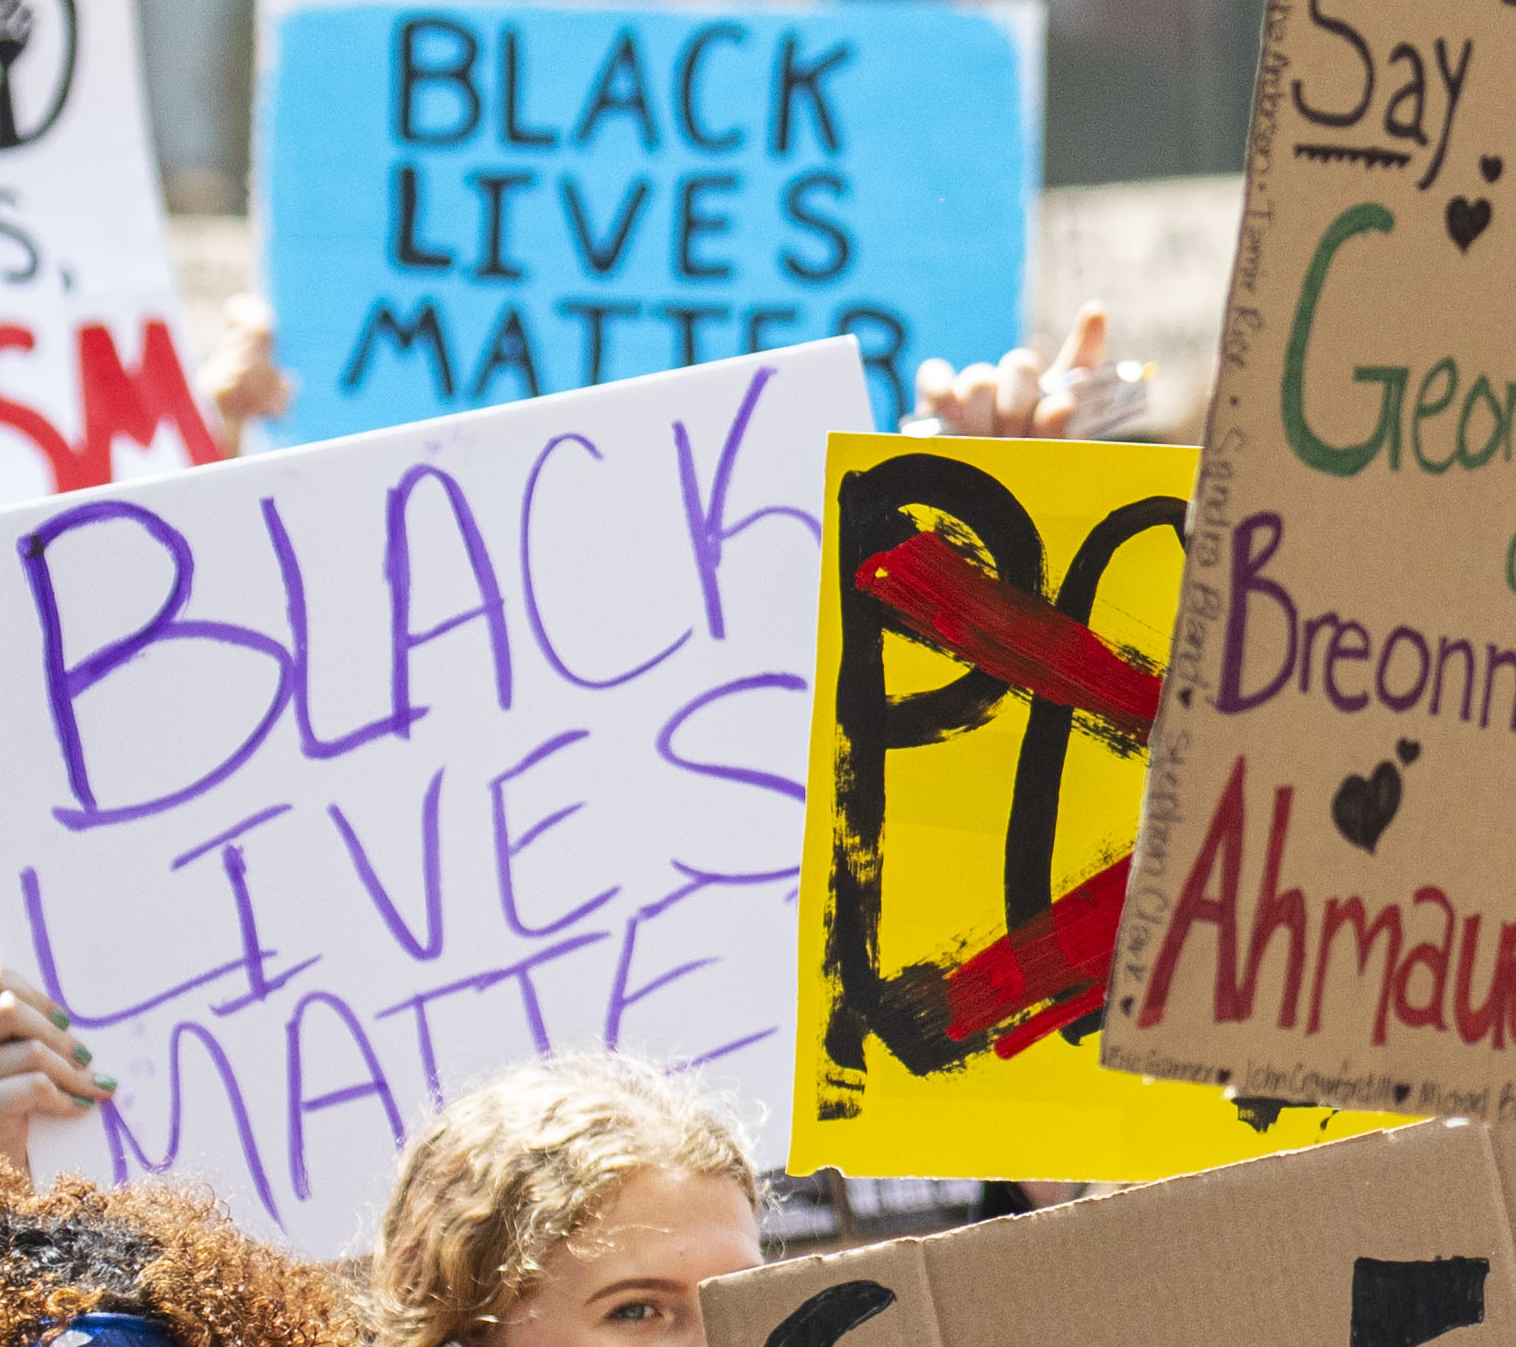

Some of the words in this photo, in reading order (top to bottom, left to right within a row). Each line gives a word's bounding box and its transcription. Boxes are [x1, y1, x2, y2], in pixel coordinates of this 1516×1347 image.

[389, 155, 857, 284] LIVES
[392, 12, 861, 157] BLACK
[14, 362, 824, 832] BLACK
[18, 670, 810, 1031] LIVES
[98, 875, 802, 1234] MATTE
